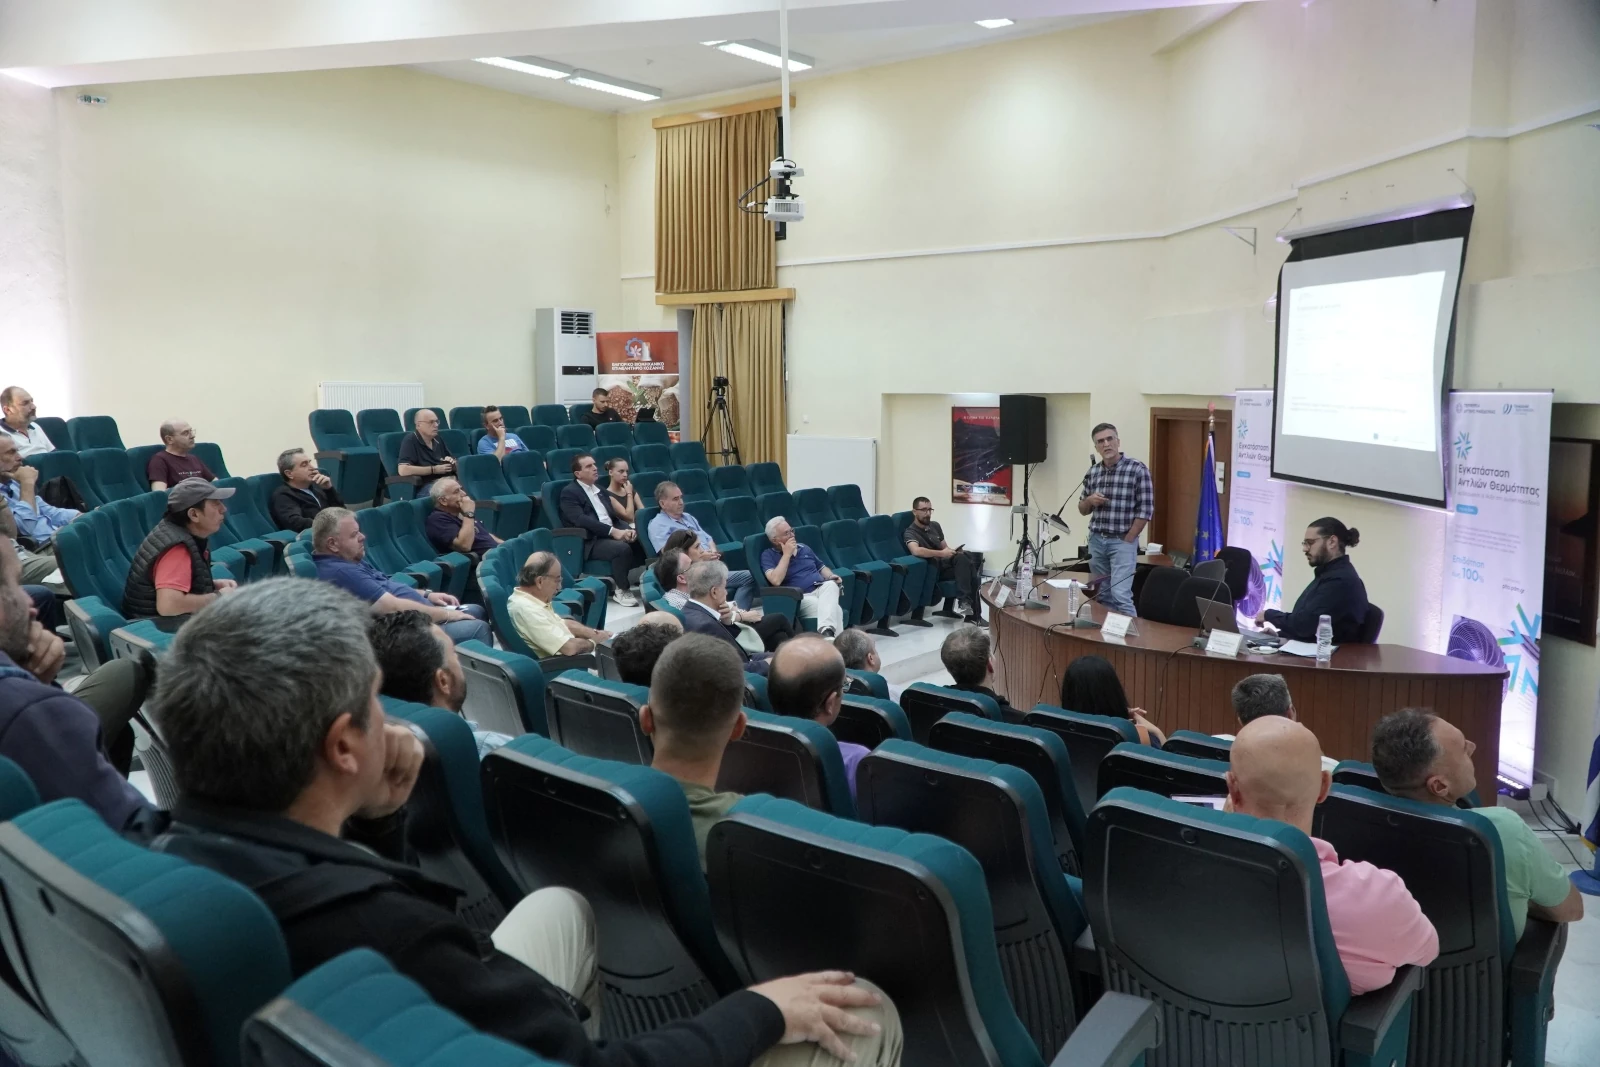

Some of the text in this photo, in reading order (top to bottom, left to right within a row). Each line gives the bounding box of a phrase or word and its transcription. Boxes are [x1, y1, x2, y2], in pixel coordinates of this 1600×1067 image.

[1458, 464, 1510, 478] Εγκατάσταση
[1458, 478, 1540, 498] Αντλιών Θερμότητας
